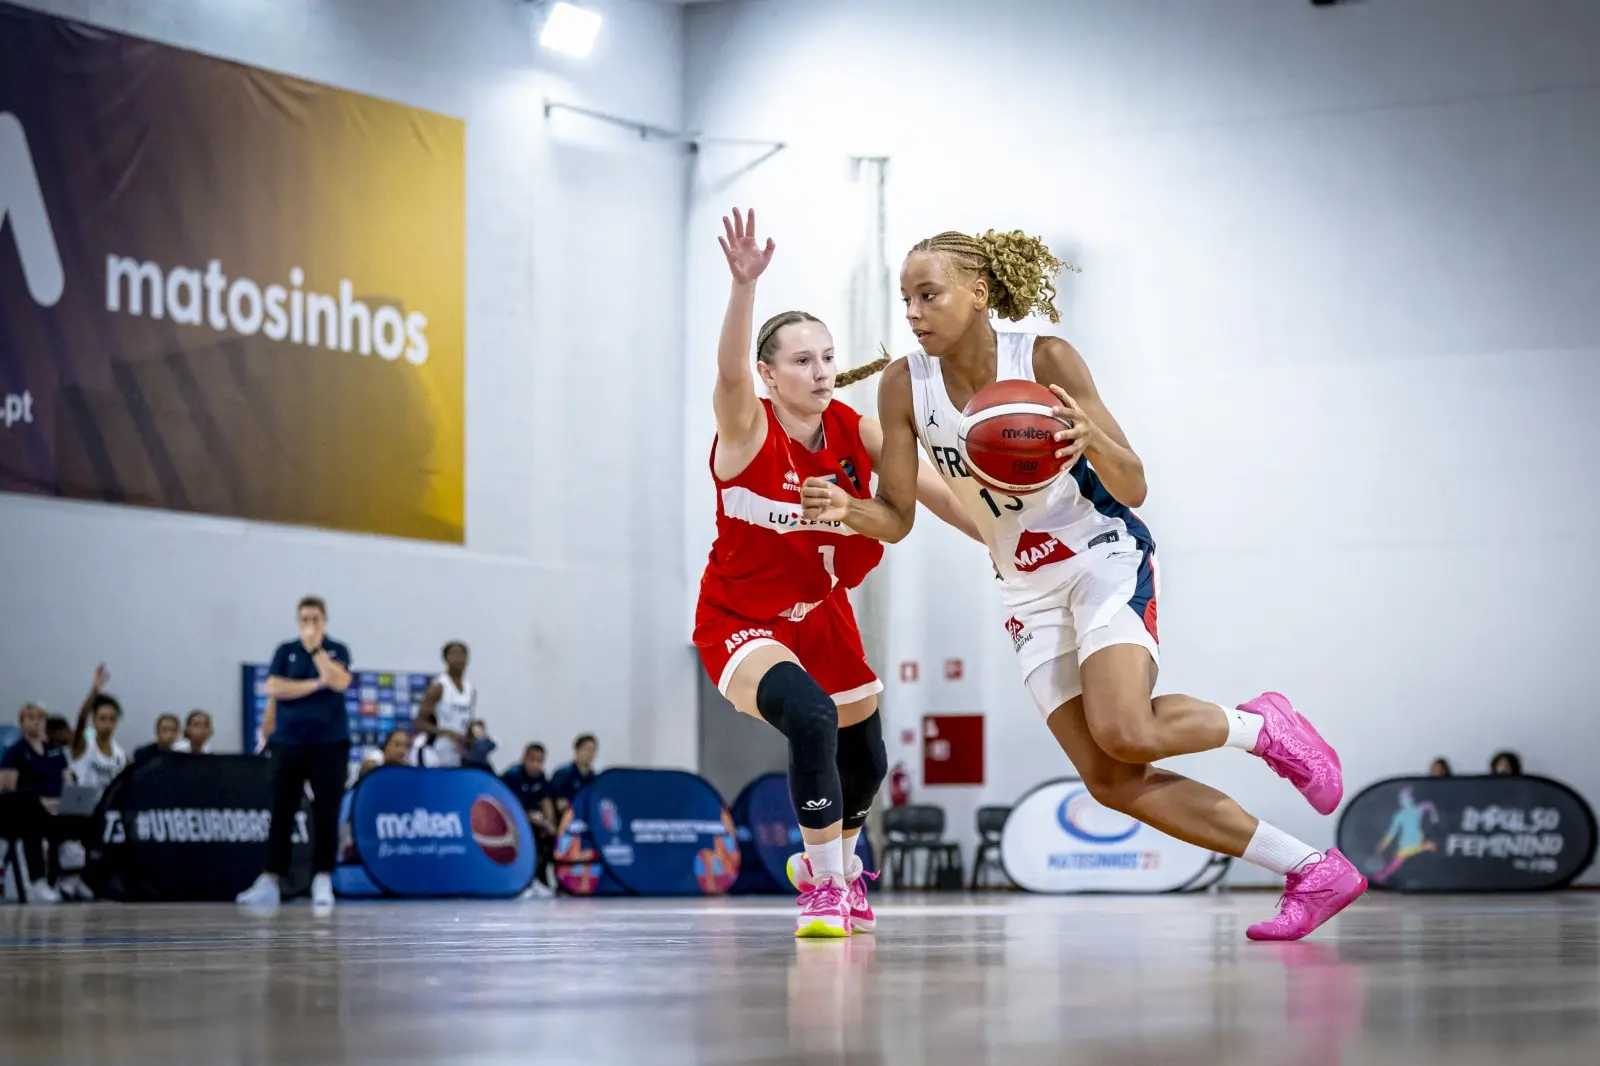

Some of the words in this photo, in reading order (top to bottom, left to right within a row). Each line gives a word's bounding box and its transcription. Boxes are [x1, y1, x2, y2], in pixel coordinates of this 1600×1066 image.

[105, 253, 428, 365] matosinhos
[1002, 427, 1052, 440] molten
[818, 545, 839, 589] 1
[1014, 538, 1059, 568] MAIF
[376, 808, 463, 839] molten
[1462, 806, 1560, 833] IMPULSO
[1446, 833, 1564, 857] FEMININO
